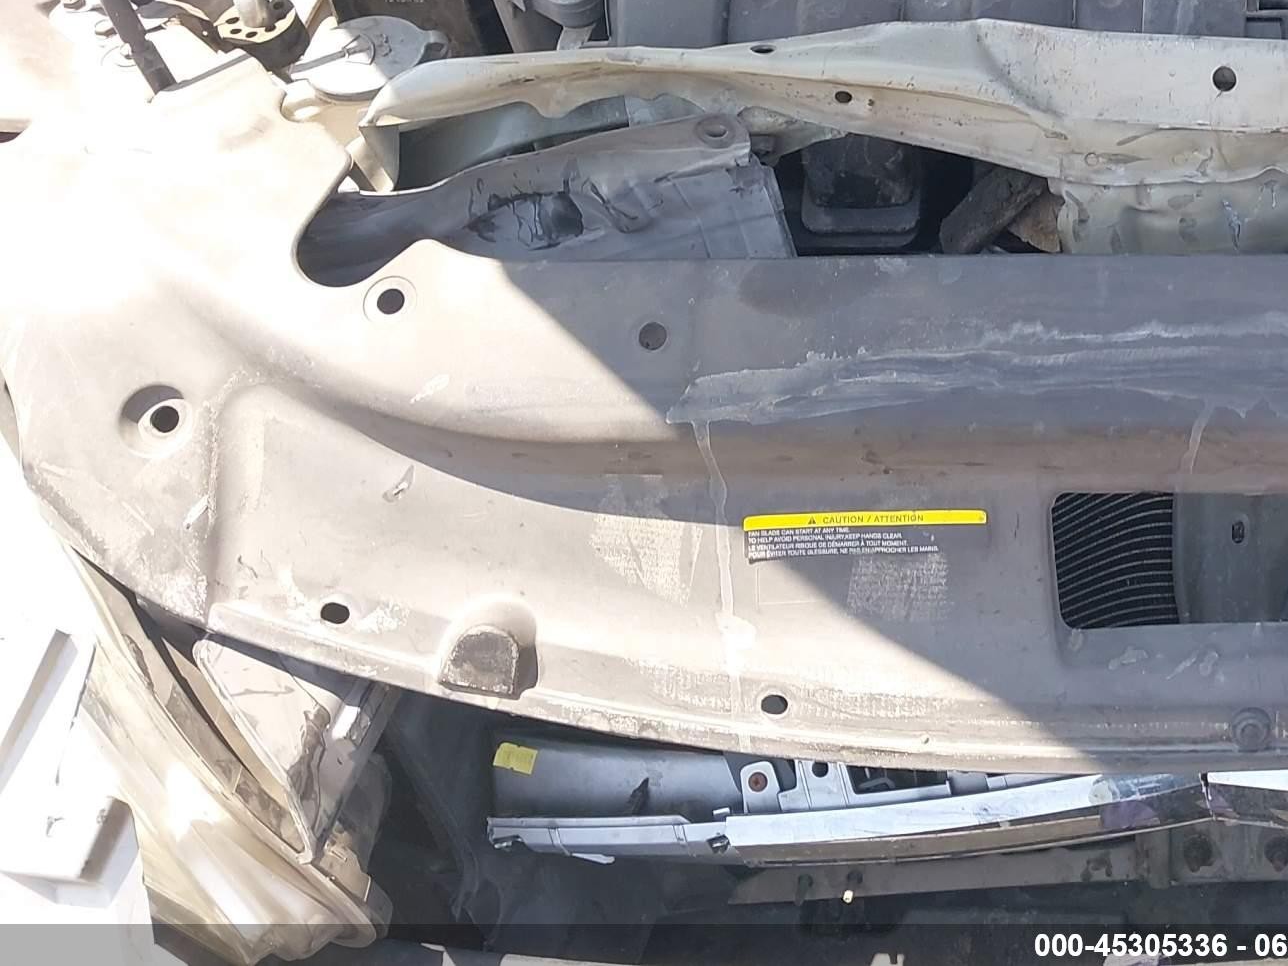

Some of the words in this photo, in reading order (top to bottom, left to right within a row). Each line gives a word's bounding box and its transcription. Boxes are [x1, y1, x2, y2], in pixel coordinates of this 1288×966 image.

[822, 515, 864, 524] CAUTION
[873, 514, 924, 523] ATTENTION
[756, 543, 795, 551] VENTILATEUR
[748, 551, 766, 559] POUR
